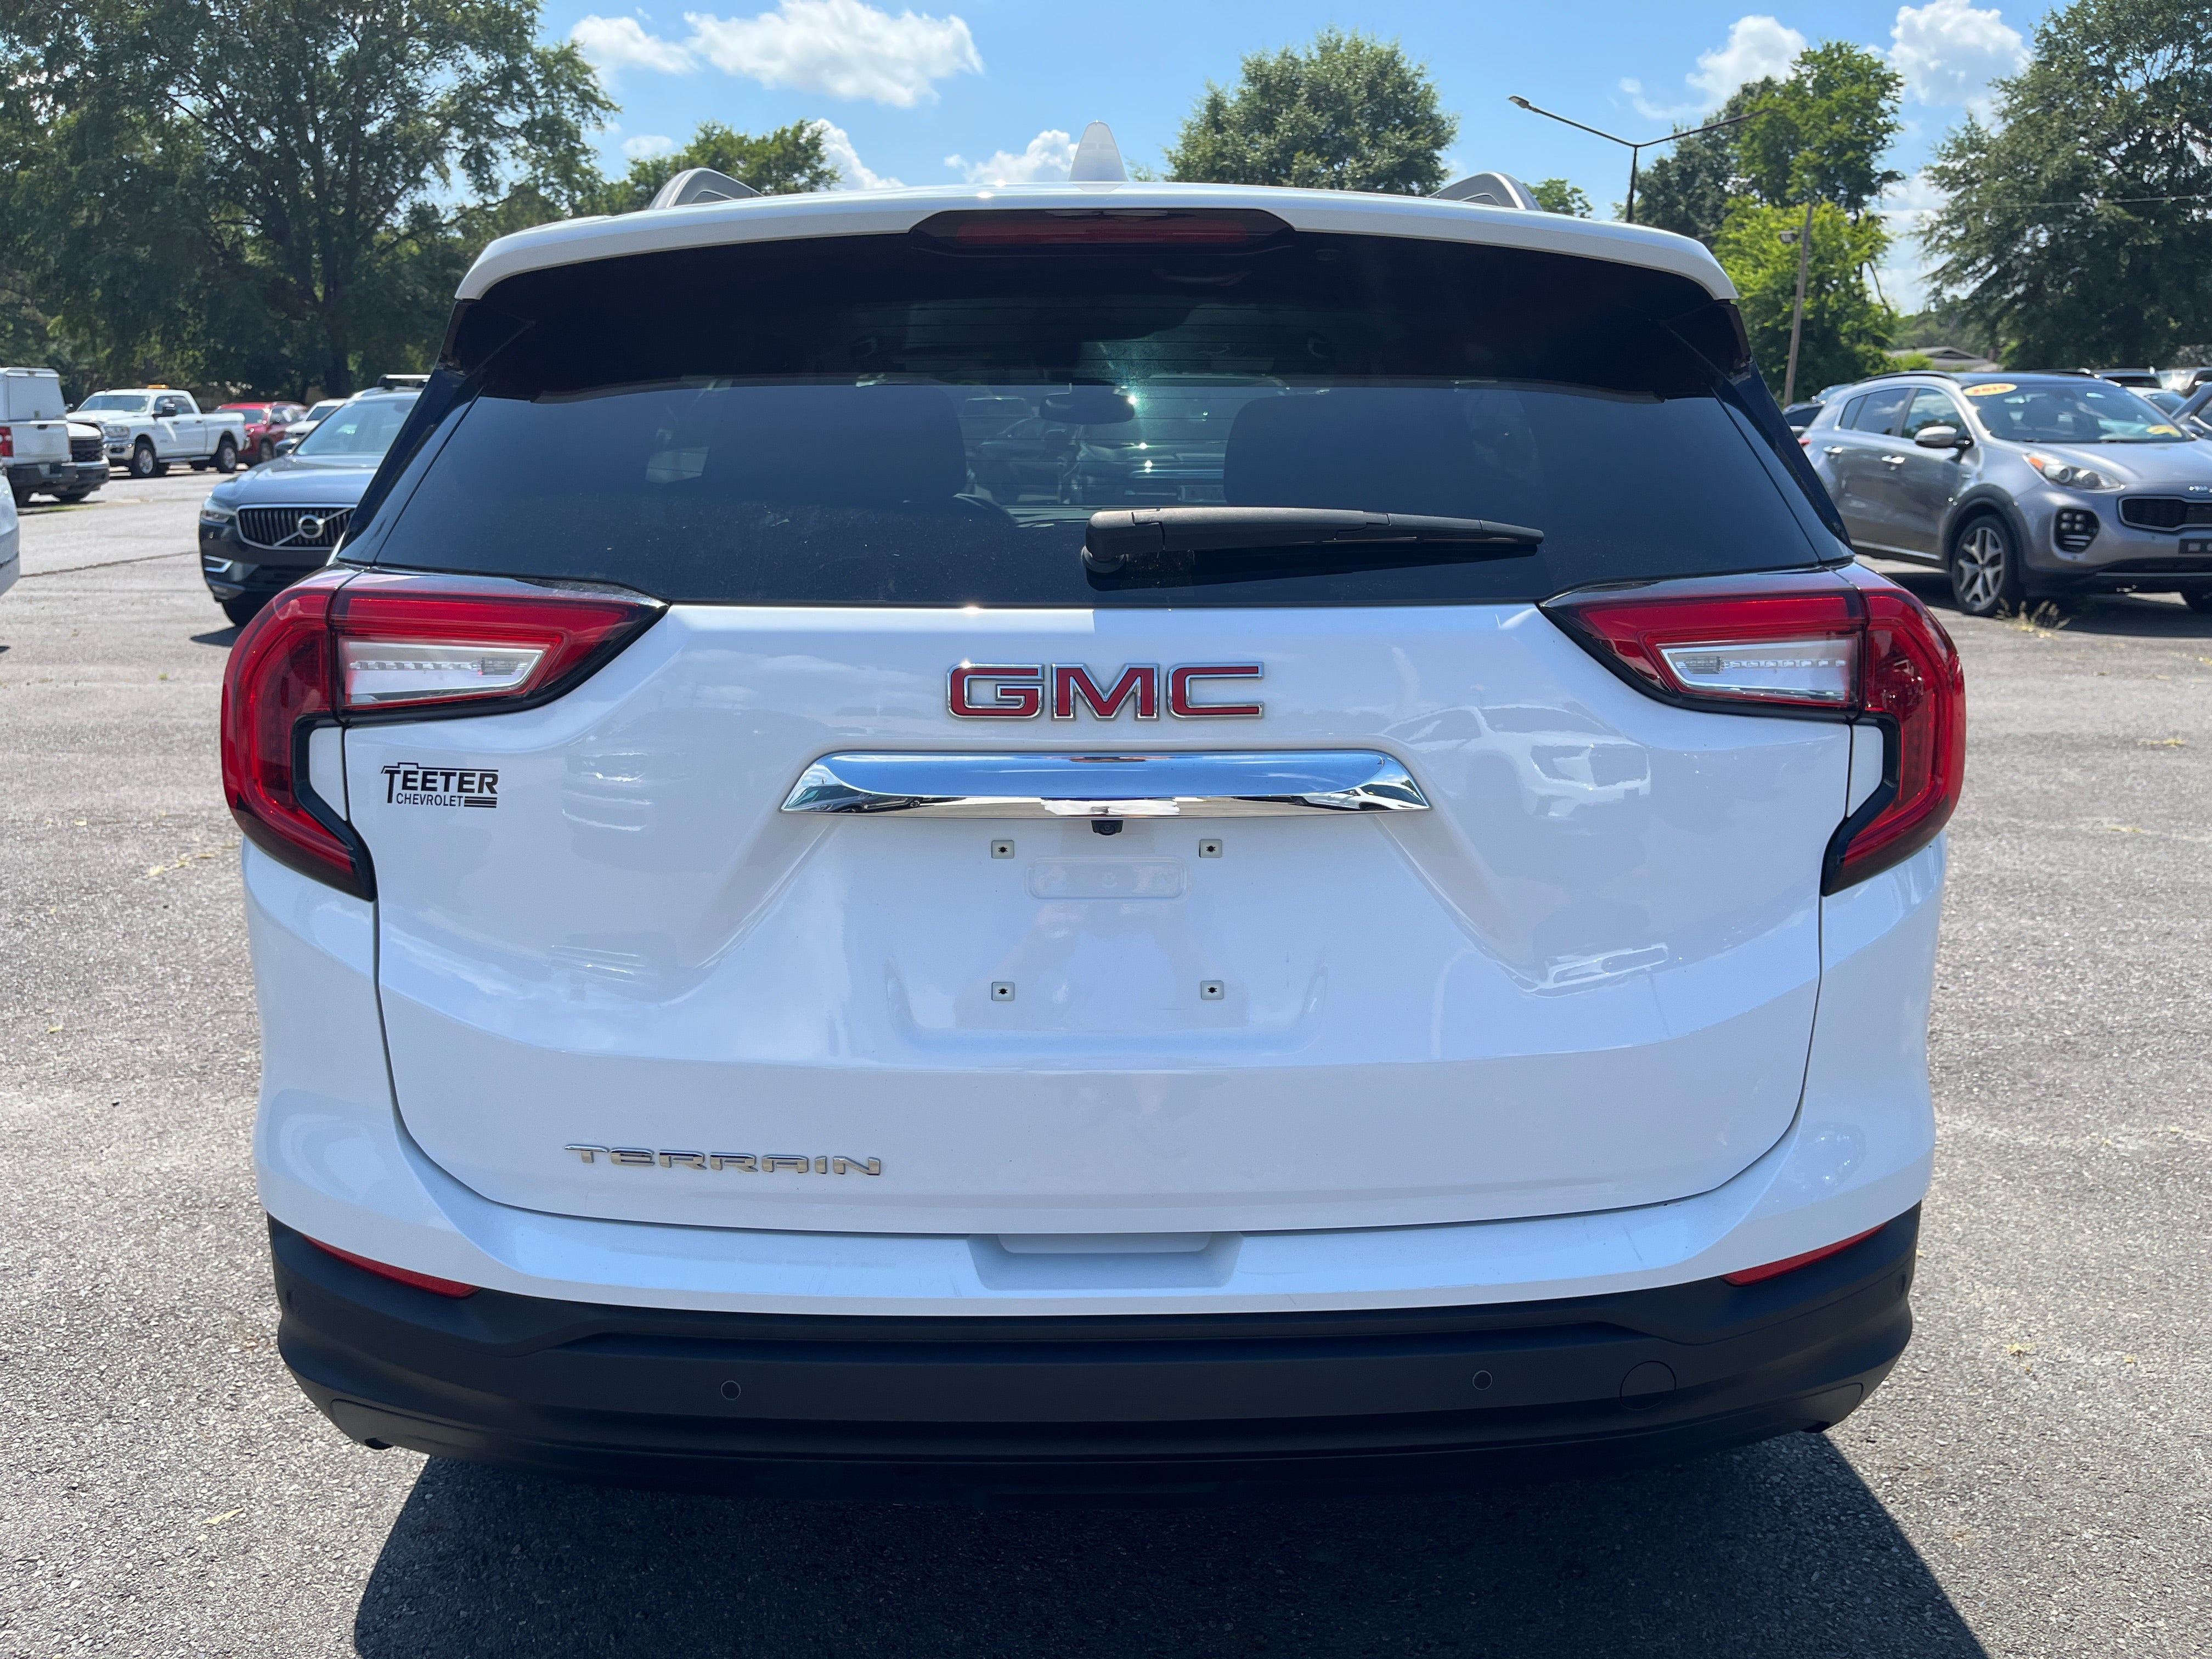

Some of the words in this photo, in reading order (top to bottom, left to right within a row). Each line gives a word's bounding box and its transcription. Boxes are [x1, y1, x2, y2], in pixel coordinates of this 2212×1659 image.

[947, 662, 1263, 720] GMC
[384, 770, 498, 803] TEETER
[396, 793, 464, 806] CHEVROLET
[564, 1144, 881, 1176] TERRAIN
